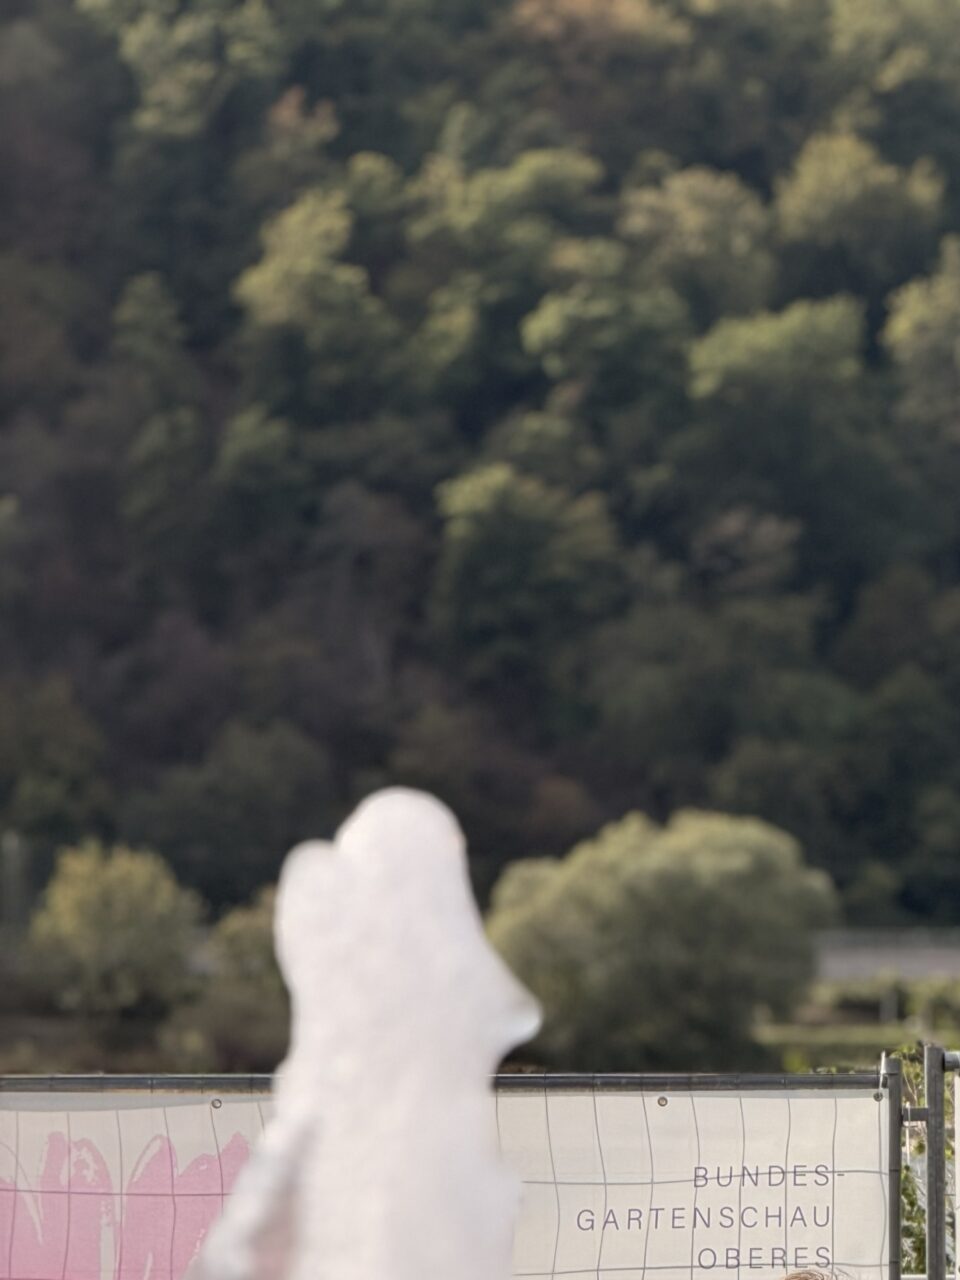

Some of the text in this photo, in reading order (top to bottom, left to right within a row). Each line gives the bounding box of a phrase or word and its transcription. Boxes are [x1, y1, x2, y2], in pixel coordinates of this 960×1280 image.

[693, 1165, 845, 1187] BUNDES-
[576, 1206, 831, 1231] GARTENSCHAU
[698, 1247, 831, 1269] OBERES
